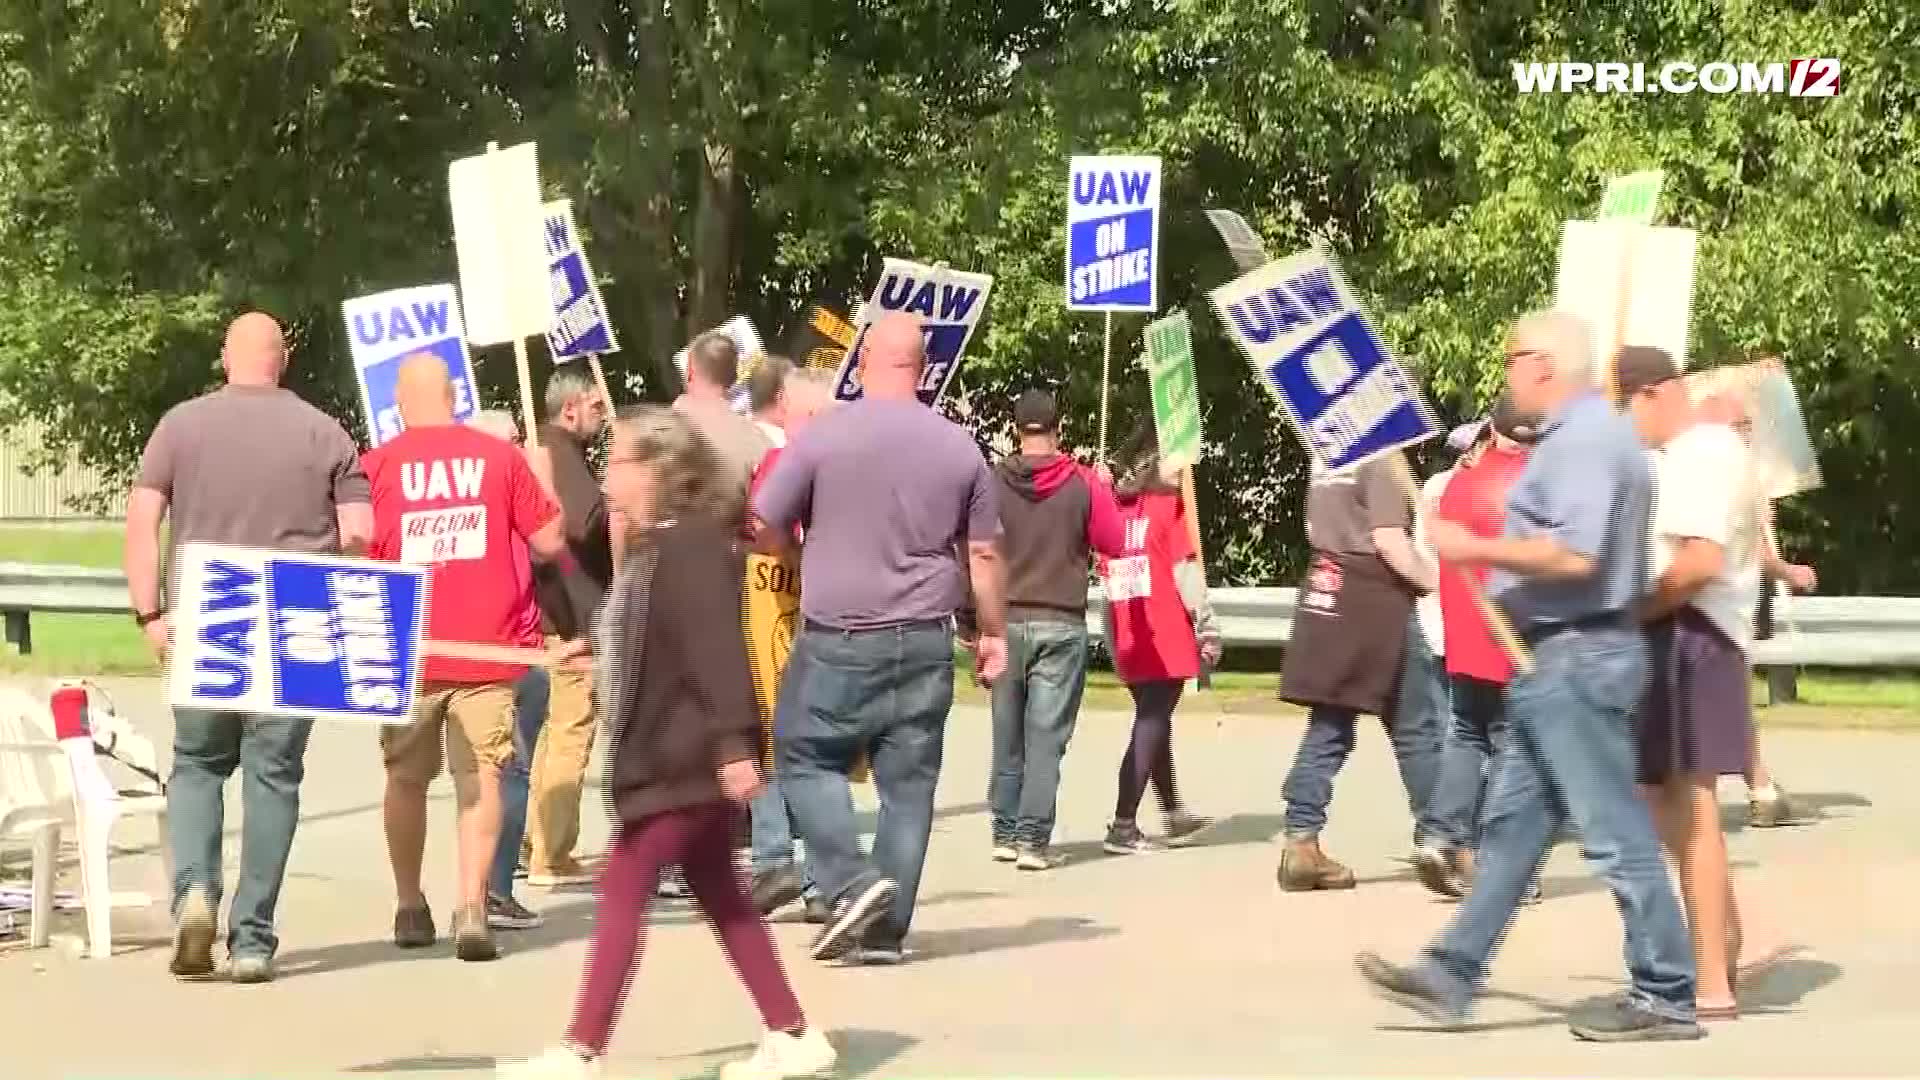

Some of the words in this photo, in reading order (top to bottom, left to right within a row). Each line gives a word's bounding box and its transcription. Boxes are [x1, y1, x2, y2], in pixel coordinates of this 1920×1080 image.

[1073, 170, 1151, 206] UAW
[1095, 217, 1127, 258] ON
[879, 274, 981, 320] UAW
[1072, 247, 1149, 301] STRIKE
[353, 301, 449, 346] UAW
[1227, 267, 1344, 344] UAW
[400, 457, 487, 502] UAW
[408, 512, 484, 538] REGION
[191, 559, 264, 698] UAW
[277, 605, 343, 664] ON
[327, 569, 404, 711] STRIKE
